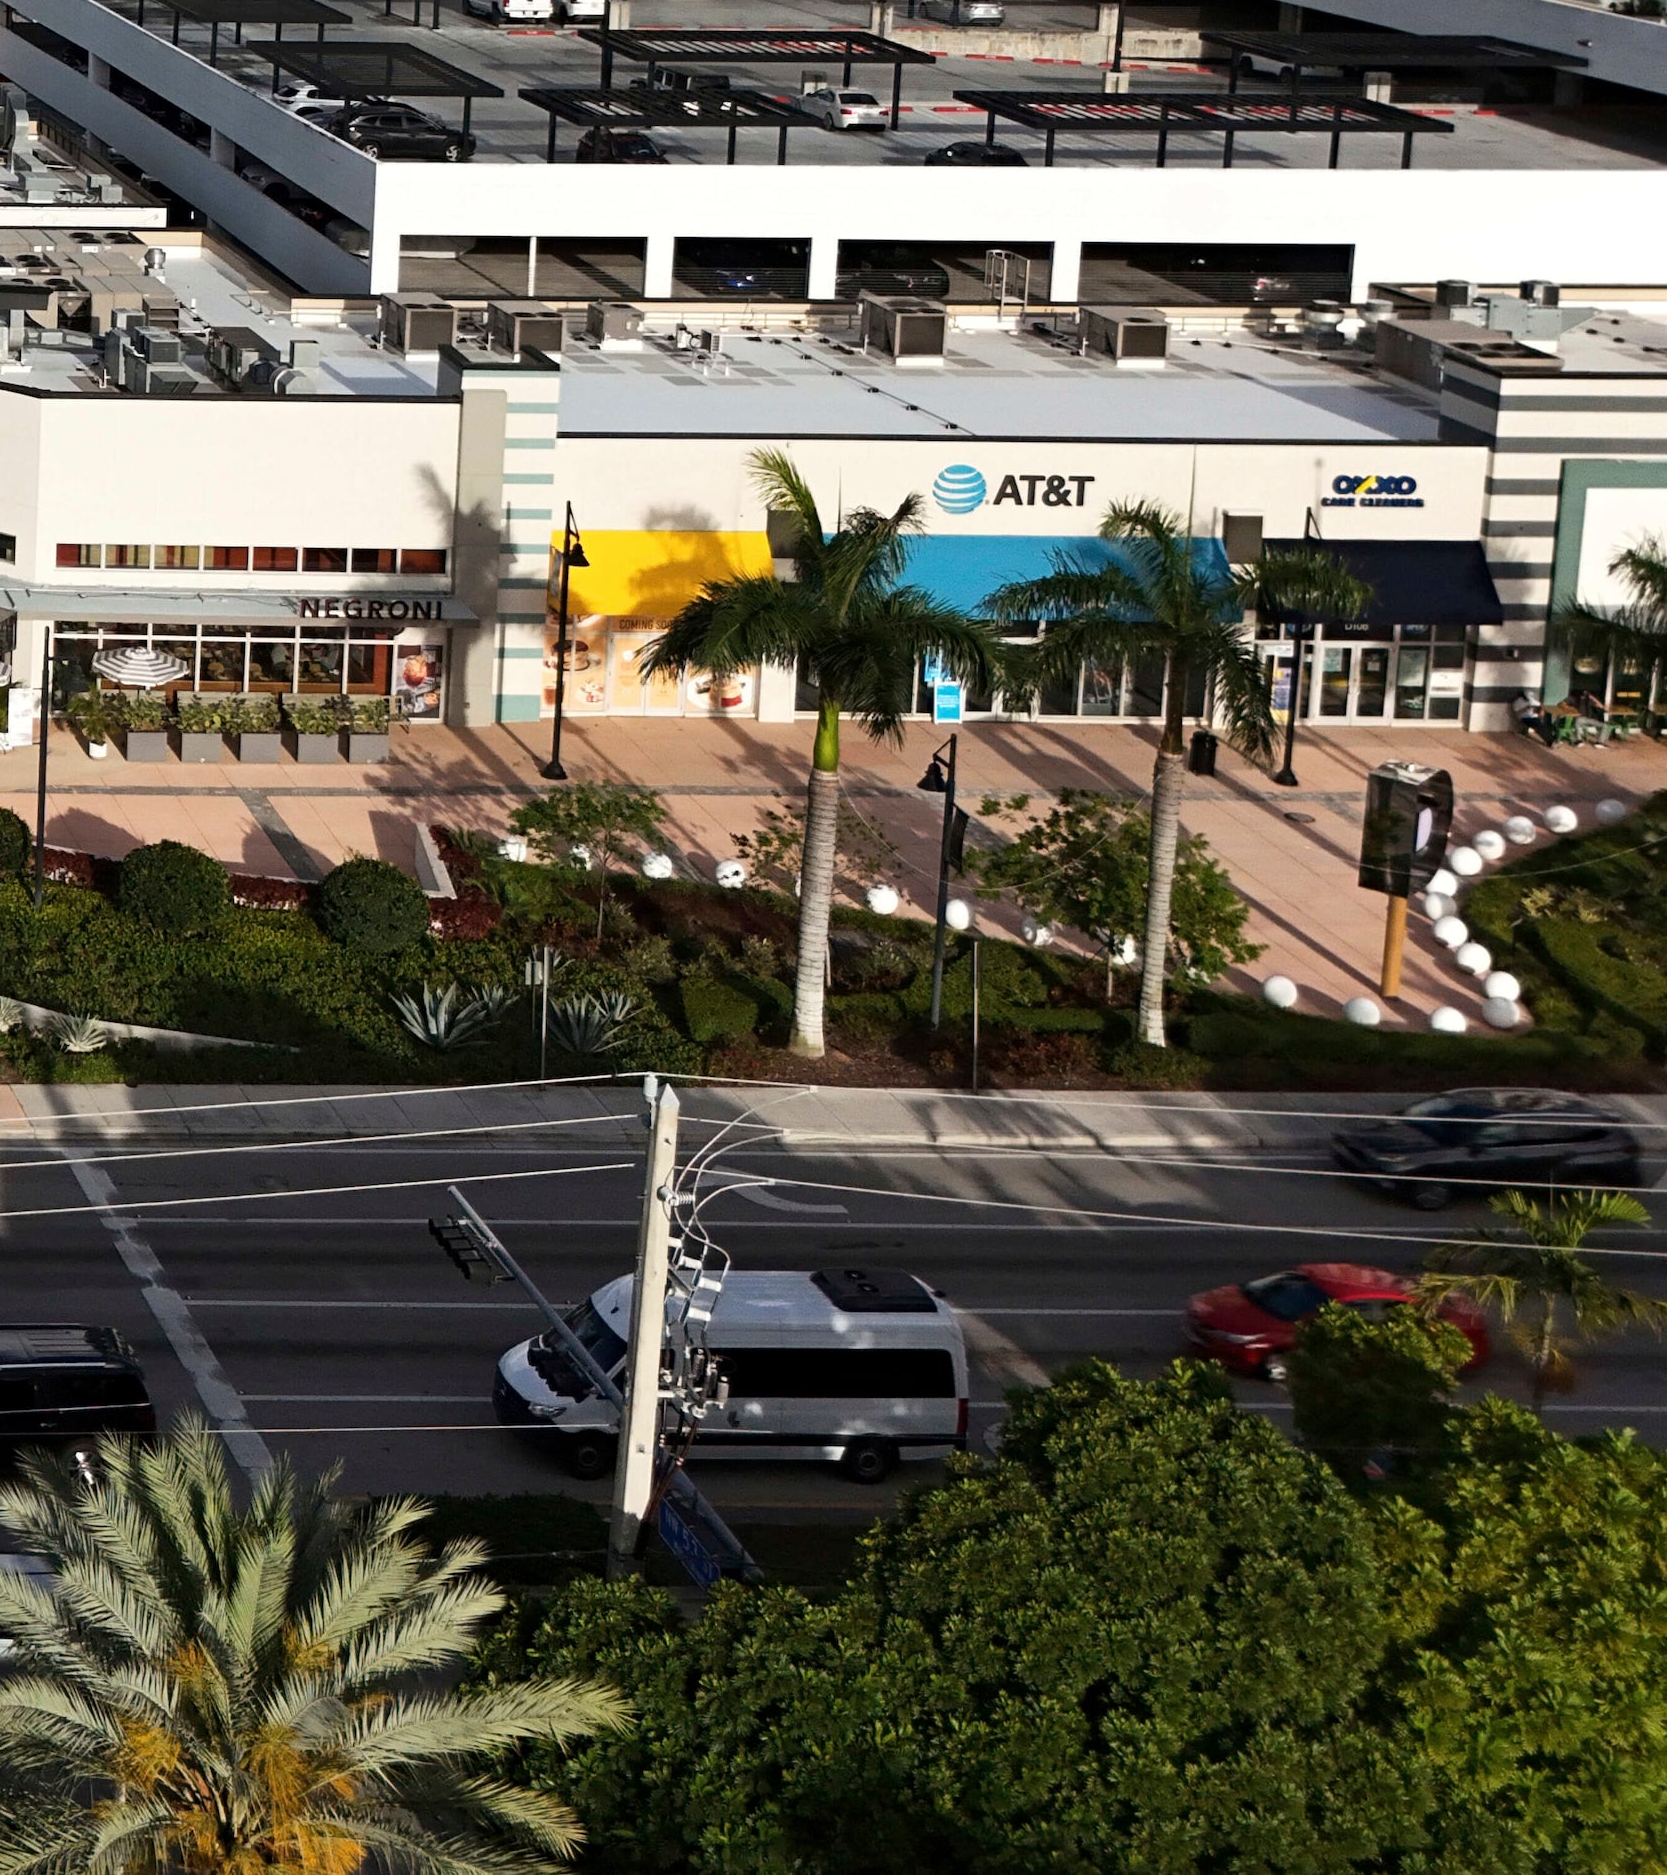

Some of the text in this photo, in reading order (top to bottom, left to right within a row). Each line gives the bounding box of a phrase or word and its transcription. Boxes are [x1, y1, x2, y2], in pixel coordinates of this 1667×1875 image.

[993, 475, 1095, 507] AT&T
[299, 597, 442, 620] NEGRONI
[619, 619, 675, 629] COMING SOO
